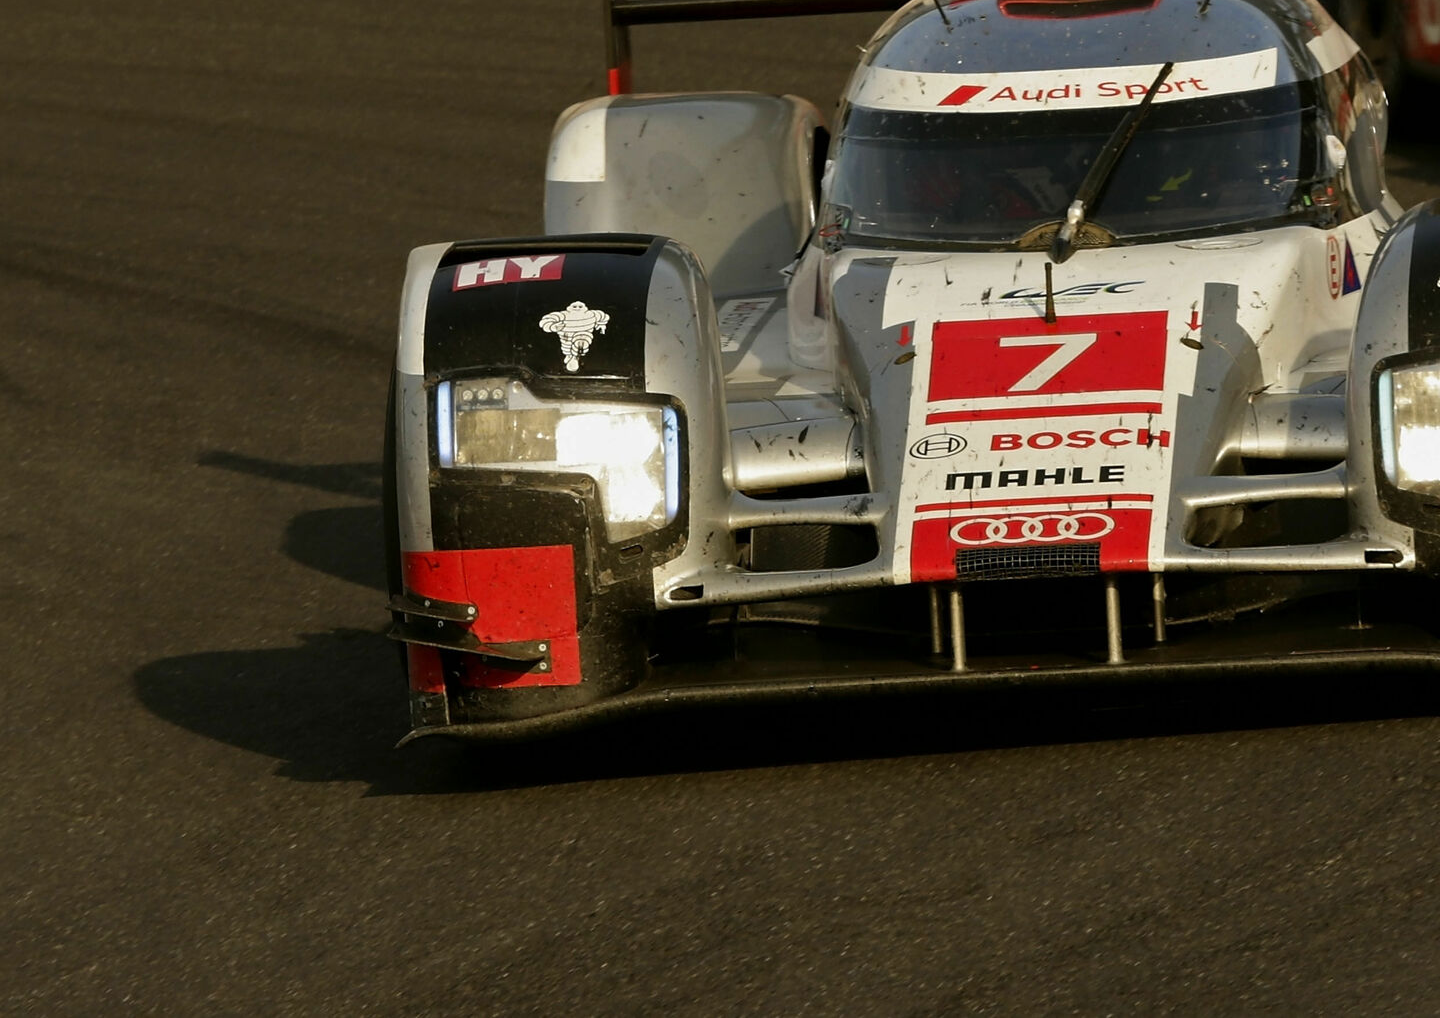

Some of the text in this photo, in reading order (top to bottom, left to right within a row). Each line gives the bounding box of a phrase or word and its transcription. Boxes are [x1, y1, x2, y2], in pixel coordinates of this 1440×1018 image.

[988, 76, 1209, 102] Audi Sport
[457, 255, 561, 288] HY
[1000, 333, 1098, 392] 7
[990, 428, 1171, 451] BOSCH
[945, 465, 1126, 490] MAHLE
